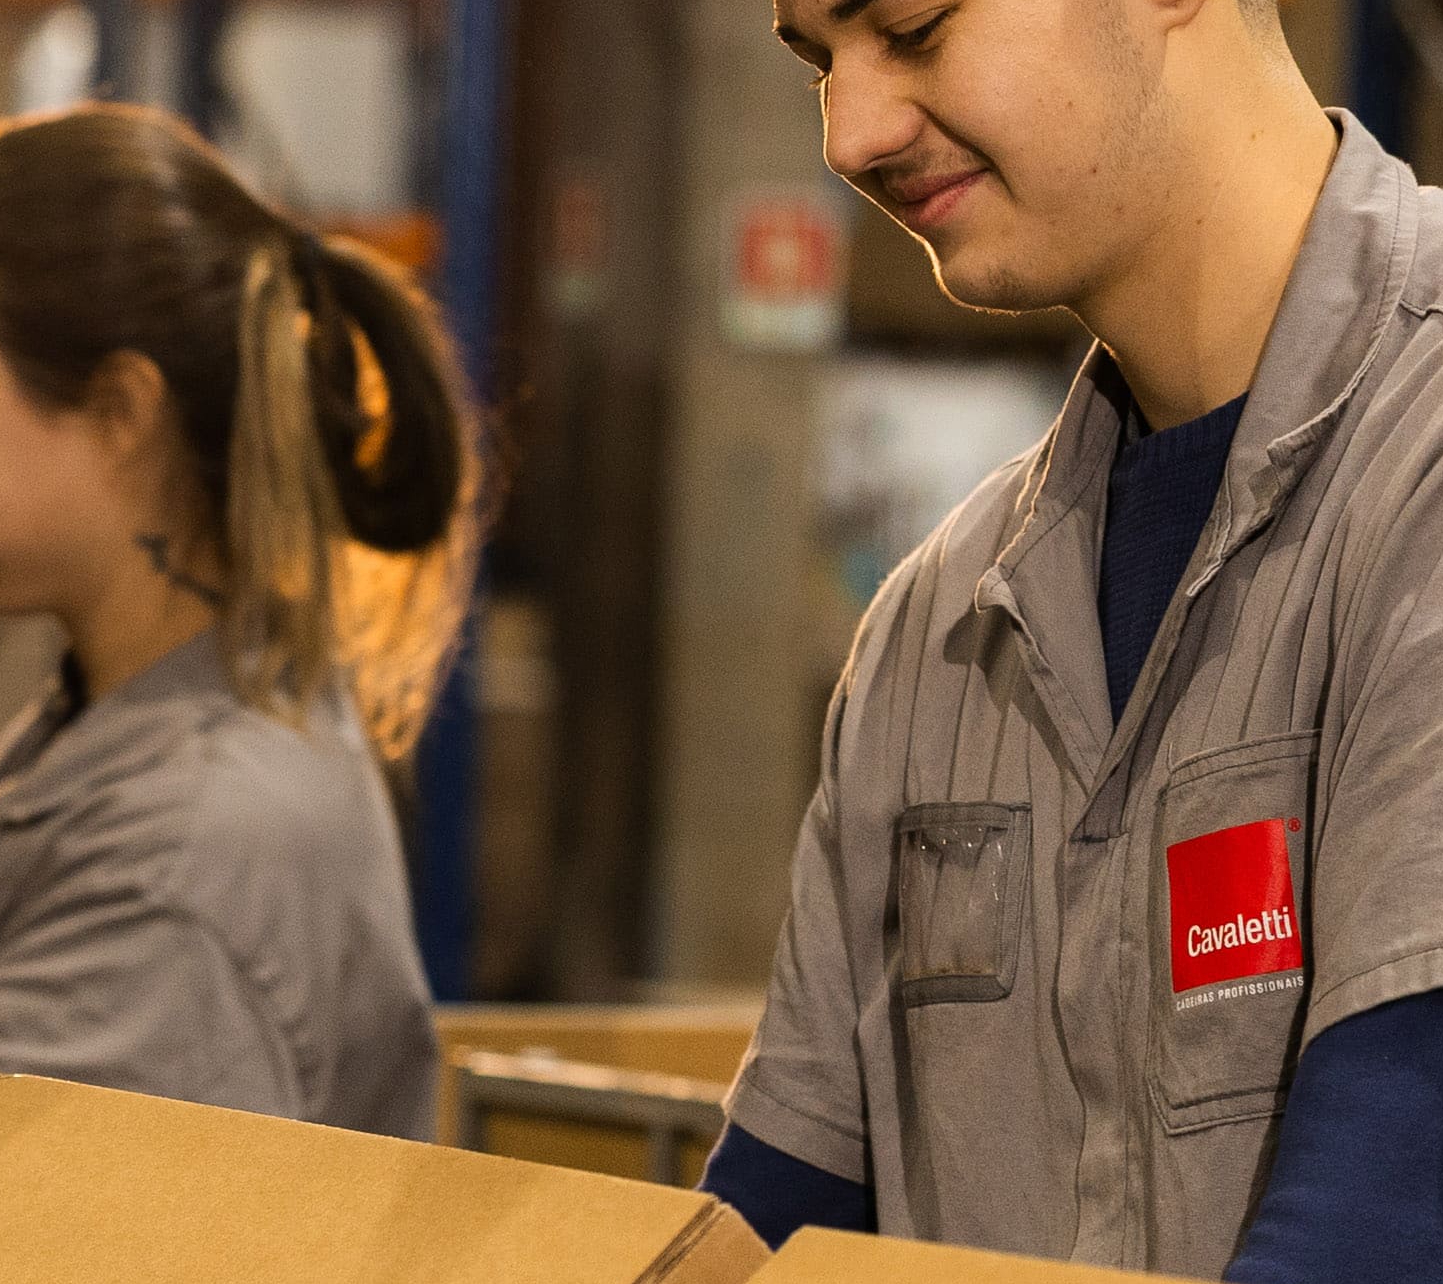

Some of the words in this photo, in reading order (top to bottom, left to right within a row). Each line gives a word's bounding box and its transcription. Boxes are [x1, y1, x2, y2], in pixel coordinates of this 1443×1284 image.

[1188, 906, 1293, 958] Cavaletti
[1176, 991, 1215, 1011] CADEIRAS
[1217, 975, 1305, 1001] PROFISSIONAIS
